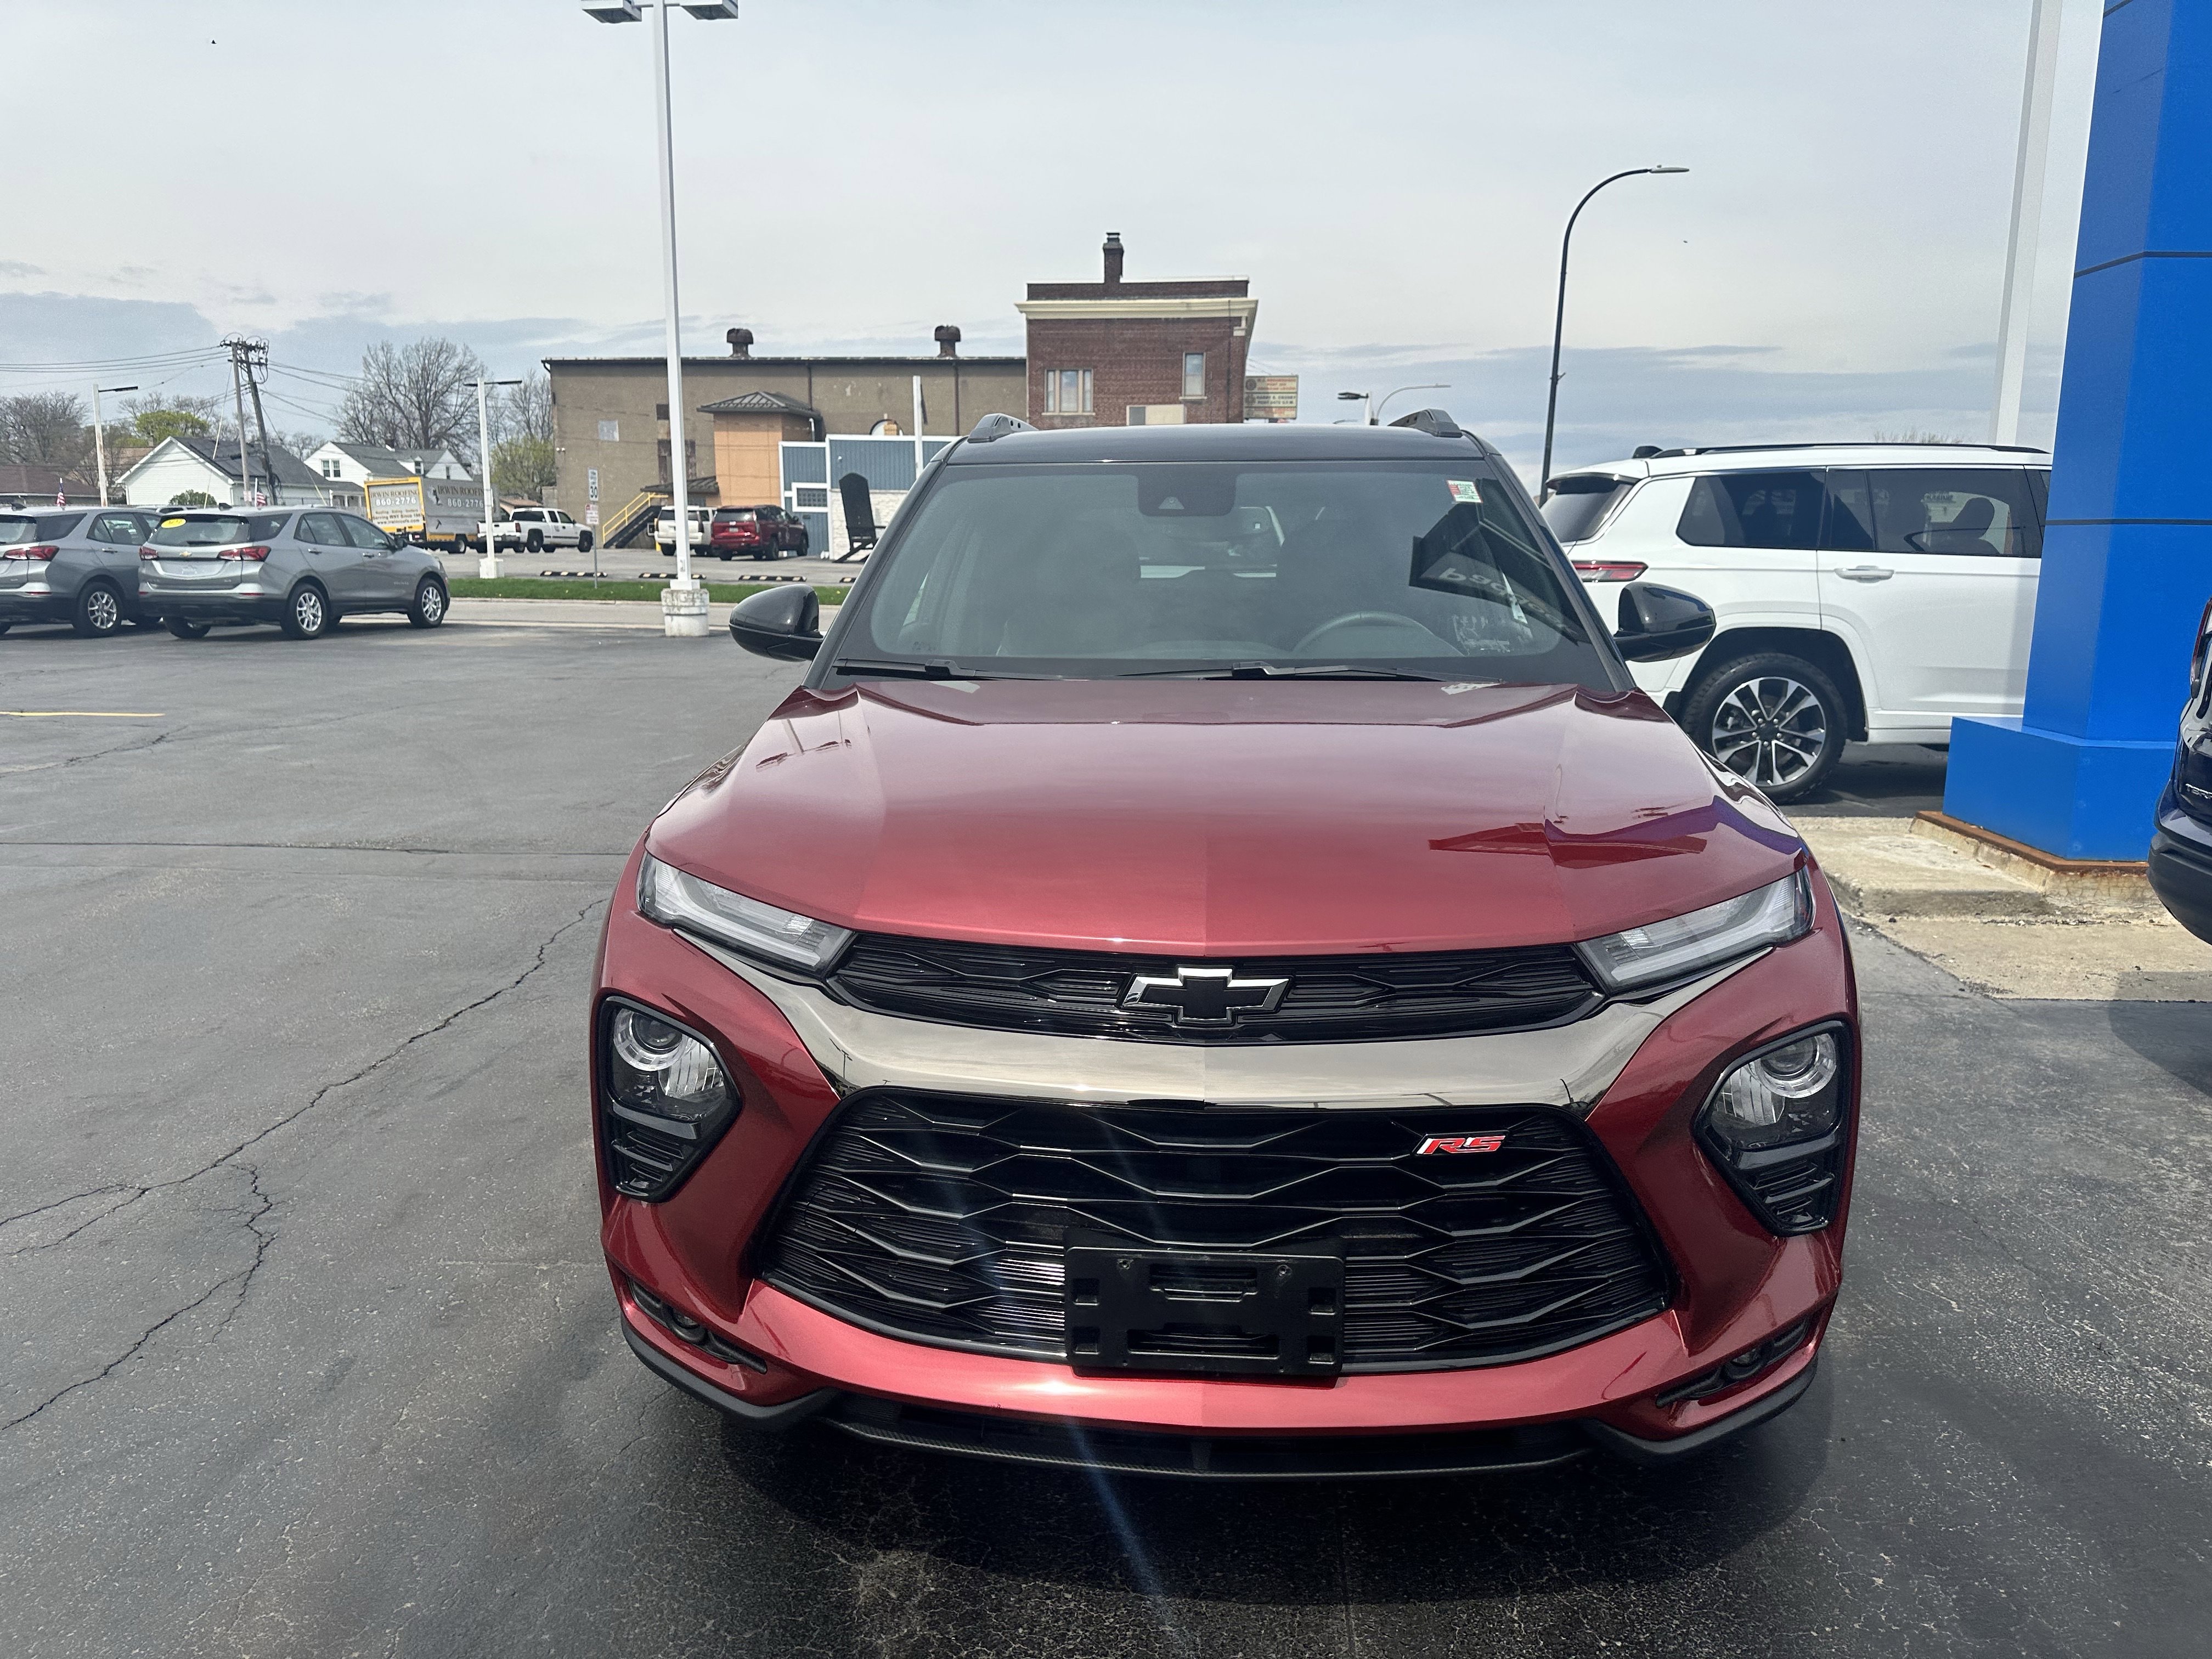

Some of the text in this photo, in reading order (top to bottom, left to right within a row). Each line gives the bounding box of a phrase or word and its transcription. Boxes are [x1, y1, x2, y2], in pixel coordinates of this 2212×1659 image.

[438, 486, 484, 496] IRWIN ROOFIN
[590, 486, 597, 498] 30
[1417, 1135, 1506, 1155] RS
